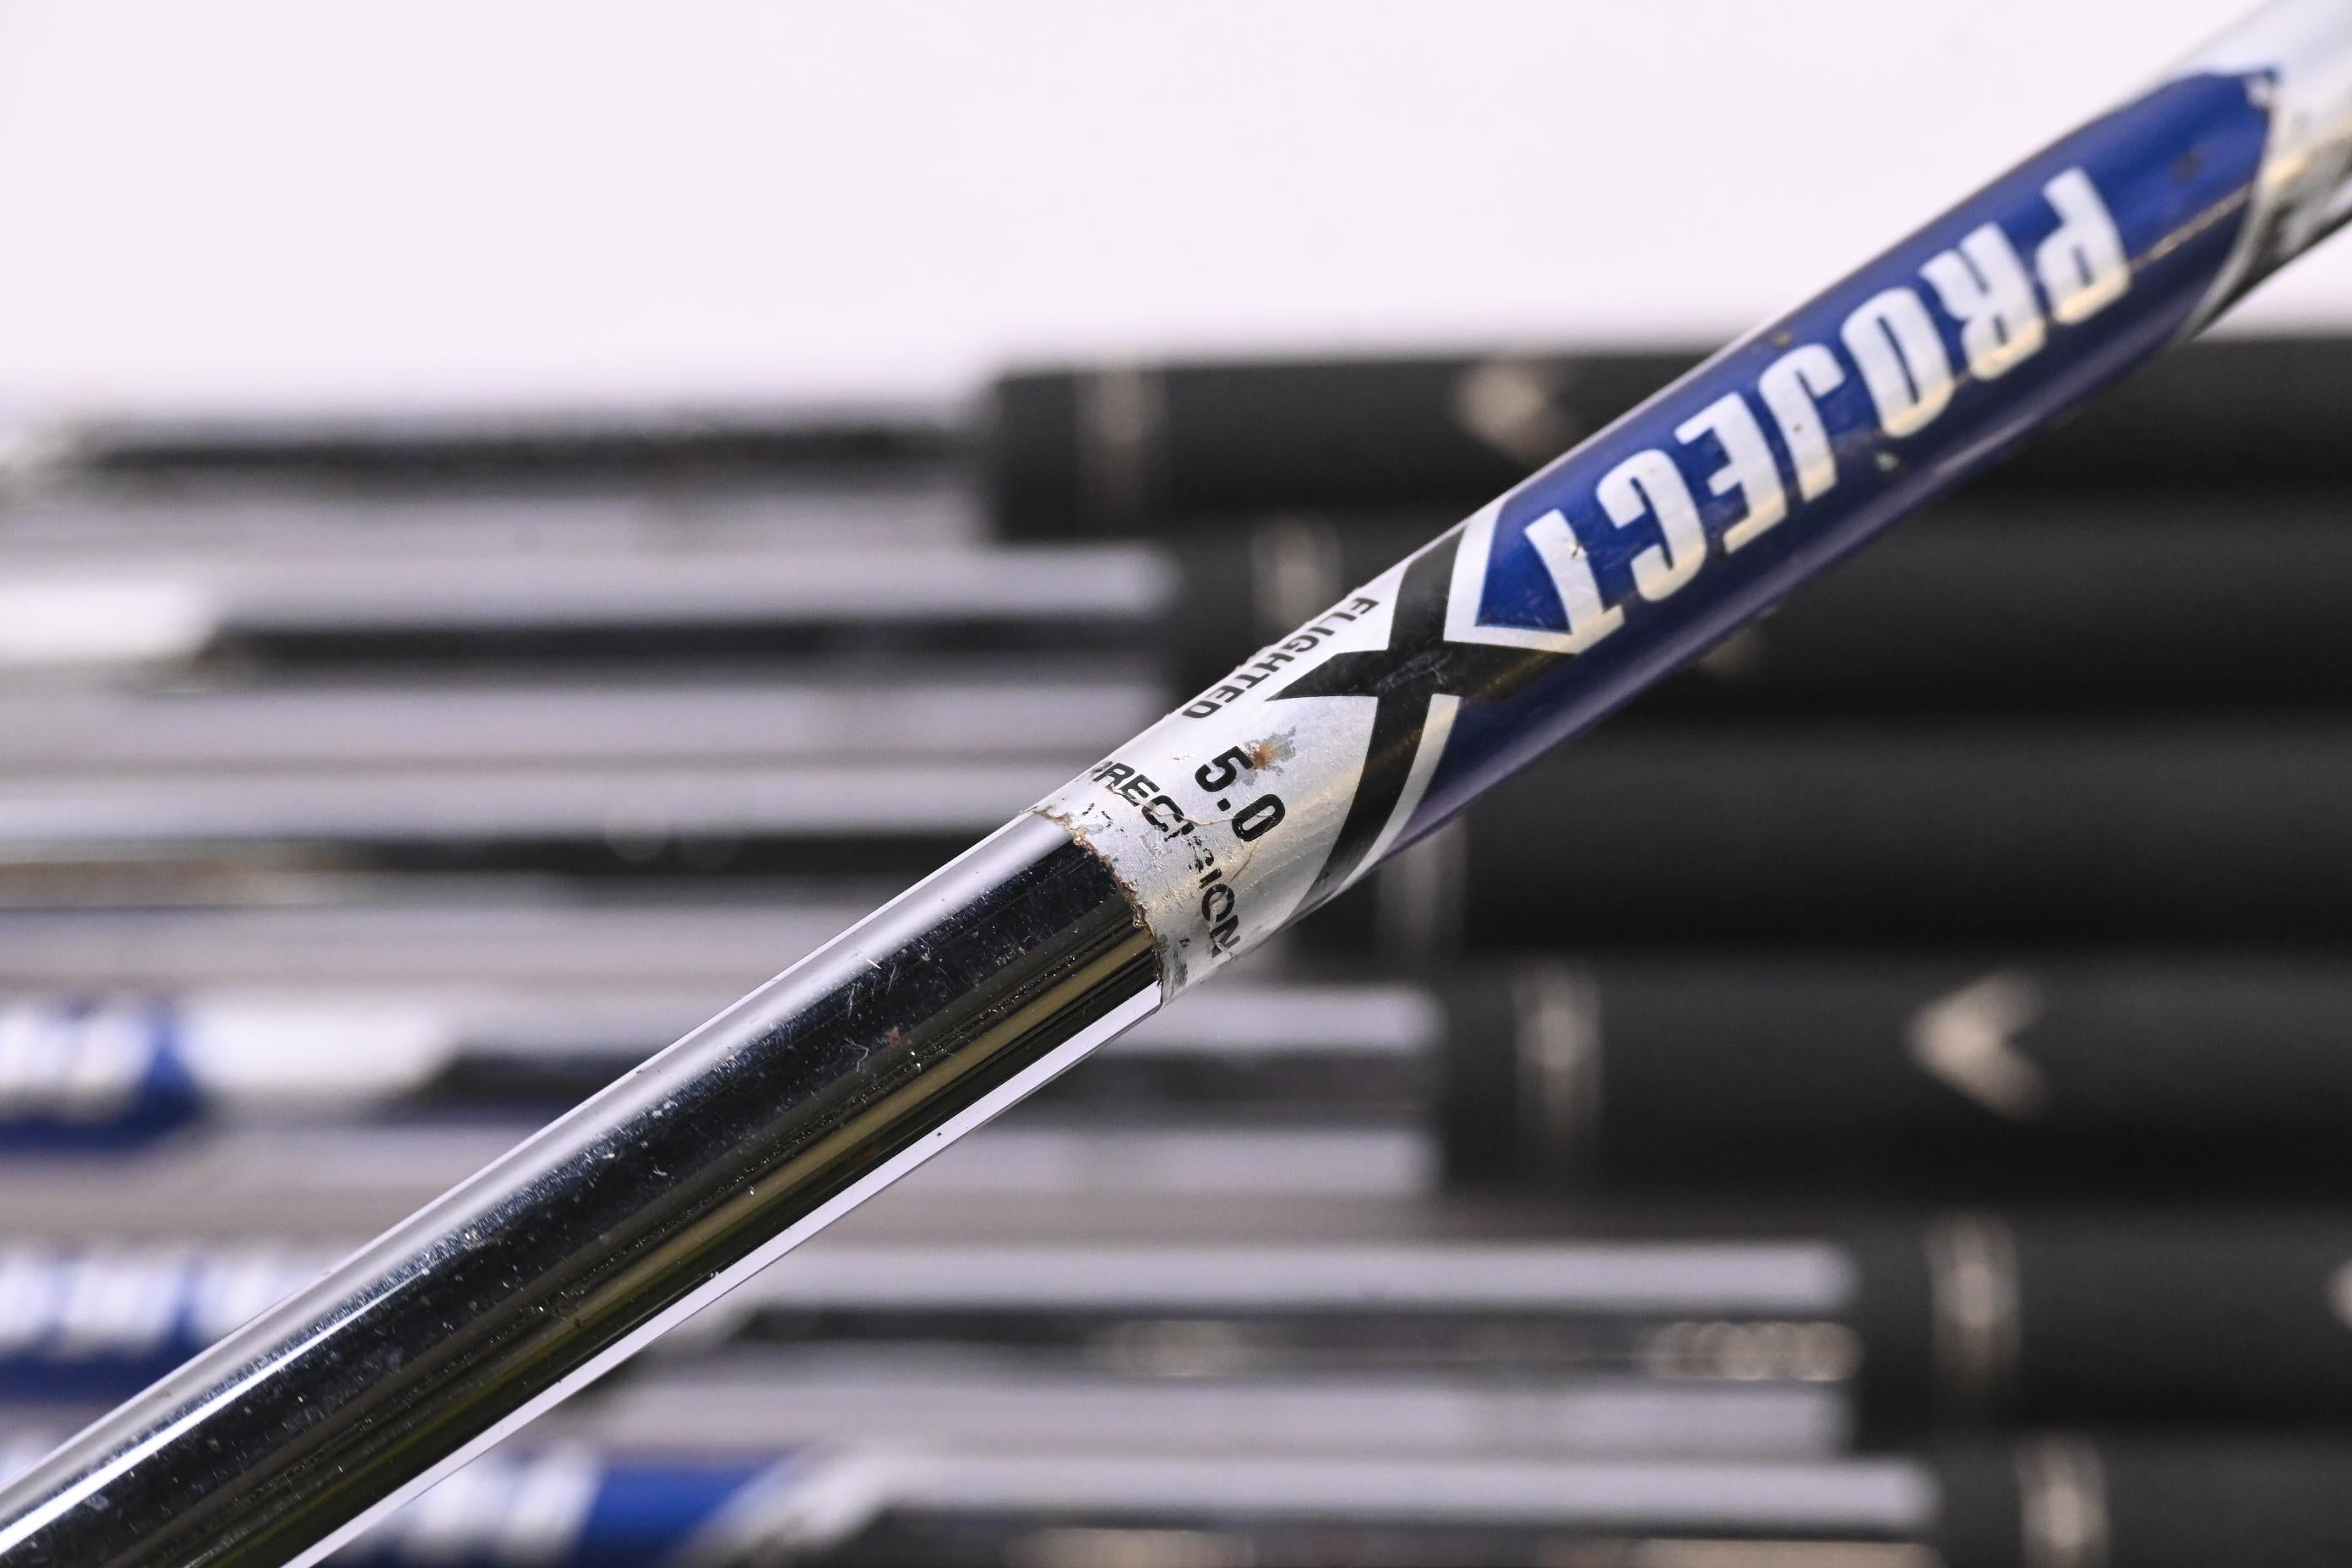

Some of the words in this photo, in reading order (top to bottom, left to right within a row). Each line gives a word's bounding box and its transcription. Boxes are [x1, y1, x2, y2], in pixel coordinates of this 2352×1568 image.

[1524, 166, 2132, 656] PROJECT
[1181, 596, 1380, 720] FLIGHTED
[1194, 745, 1287, 843] 5.0
